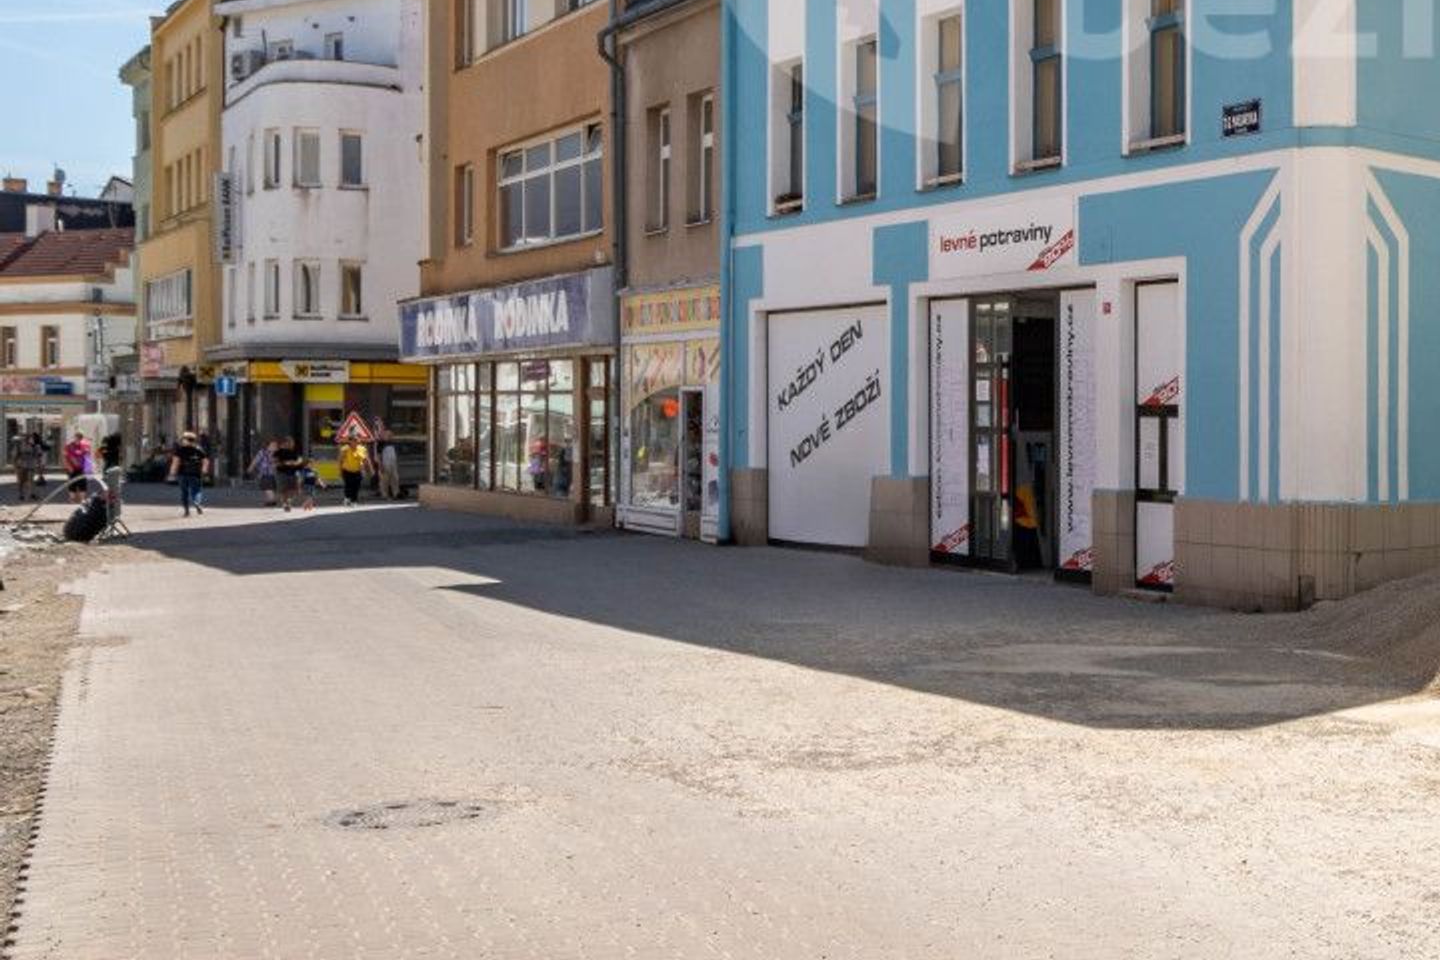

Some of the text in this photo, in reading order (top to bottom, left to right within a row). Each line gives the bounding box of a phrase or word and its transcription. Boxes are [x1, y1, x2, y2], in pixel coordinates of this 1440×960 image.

[940, 230, 977, 253] levné
[979, 223, 1053, 252] potraviny
[777, 320, 863, 411] KAŽDÝ DEN
[790, 368, 881, 468] NOVÉ ZBOŽÍ
